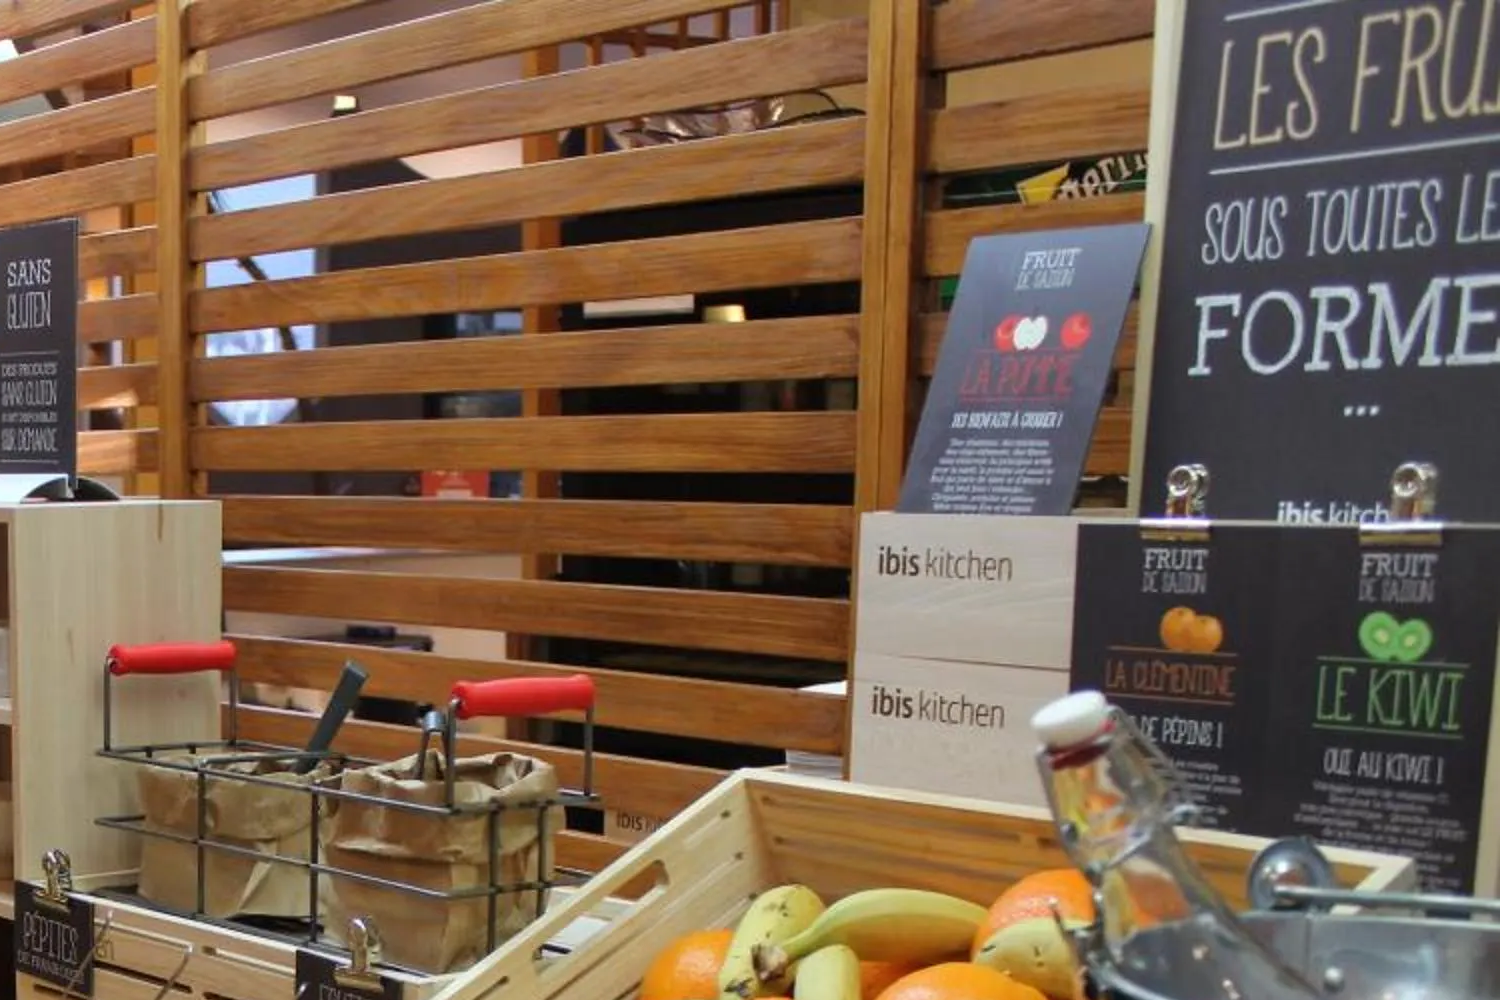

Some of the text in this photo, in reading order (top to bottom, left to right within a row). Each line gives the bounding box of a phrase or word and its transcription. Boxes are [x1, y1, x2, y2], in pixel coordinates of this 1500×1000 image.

[1213, 0, 1500, 150] LES FRU
[1201, 195, 1288, 265] SOUS
[1305, 177, 1443, 257] TOUTES
[6, 258, 52, 288] SANS
[1021, 248, 1083, 270] FRUIT
[6, 290, 52, 330] GLUTEN
[1277, 501, 1323, 525] ibis
[877, 545, 1014, 583] ibis kitchen
[1142, 548, 1210, 571] FRUIT
[1360, 552, 1440, 578] FRUIT
[1104, 658, 1238, 699] LA CLÉMENTINE
[1315, 664, 1465, 731] LE KIWI
[871, 685, 1006, 730] ibis kitchen
[1161, 713, 1213, 748] PÉPINS
[1323, 747, 1355, 776] OUI
[1357, 750, 1381, 780] AU
[1385, 752, 1431, 785] KIWI
[22, 909, 80, 966] PÉPITES
